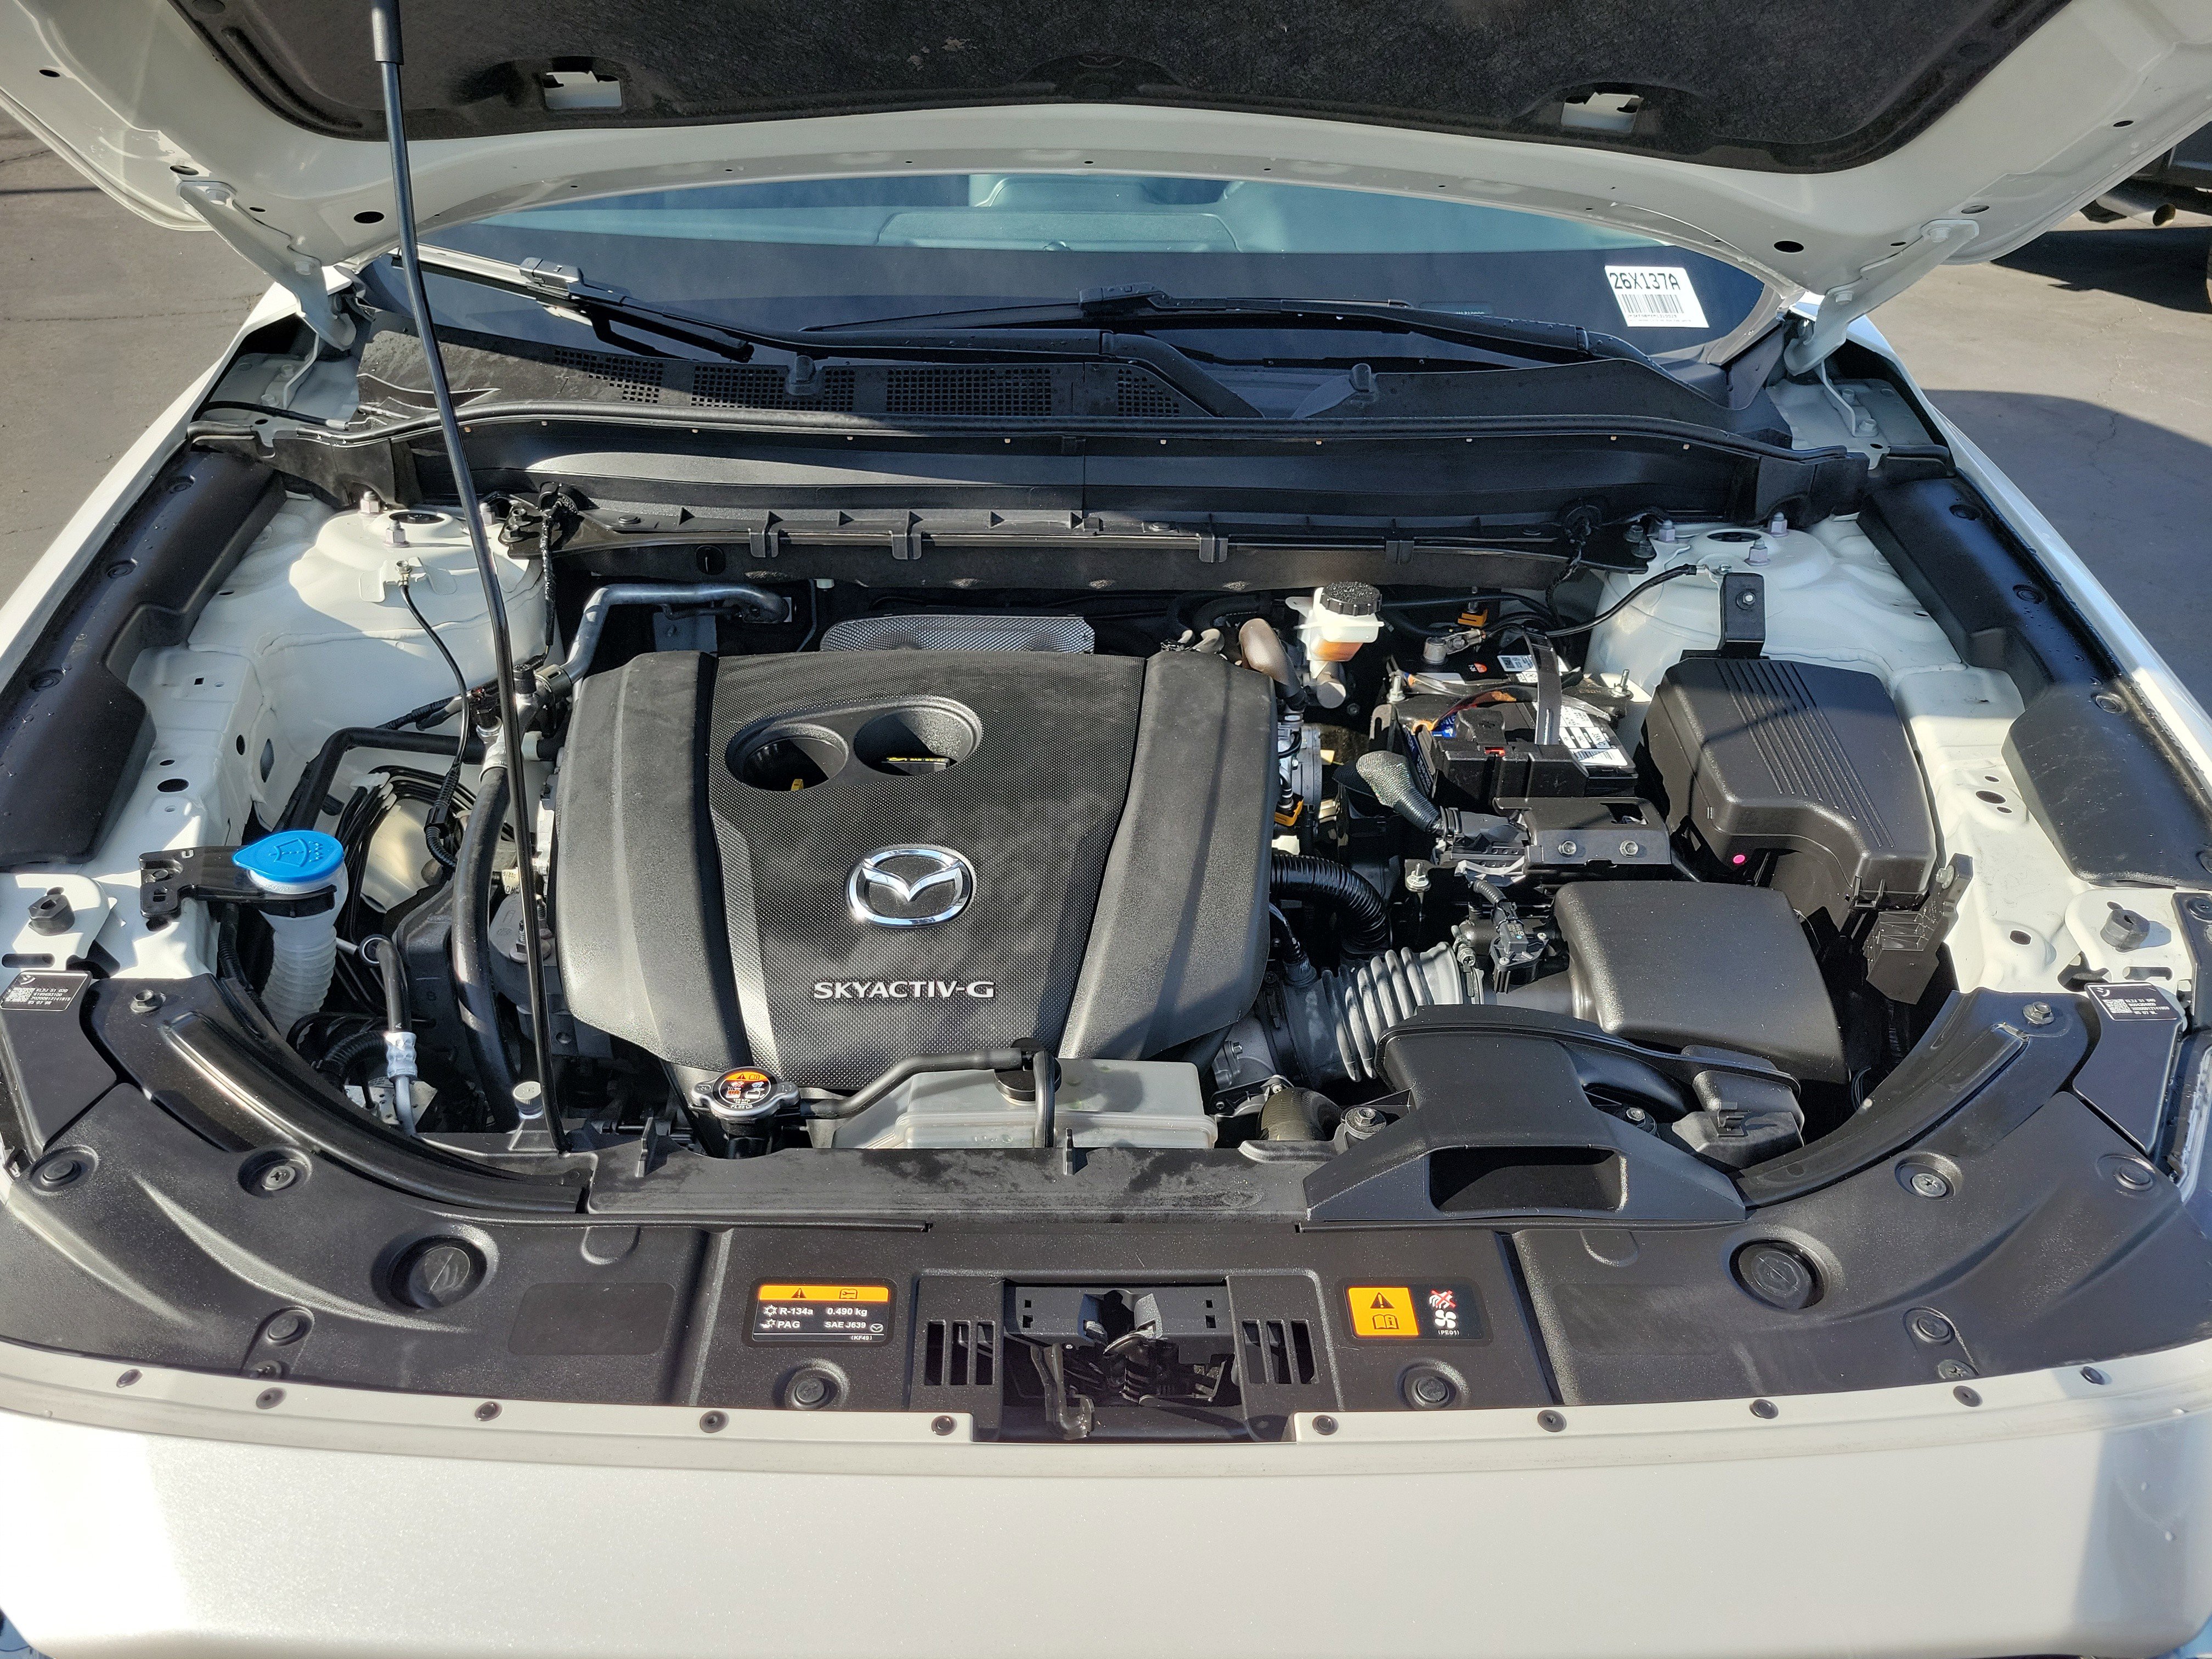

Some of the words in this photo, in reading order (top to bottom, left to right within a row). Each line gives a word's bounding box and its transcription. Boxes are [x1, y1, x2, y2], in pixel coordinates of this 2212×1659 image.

[1610, 273, 1681, 290] 26X137A
[814, 980, 996, 999] SKYACTIV-G
[855, 1308, 868, 1317] kg
